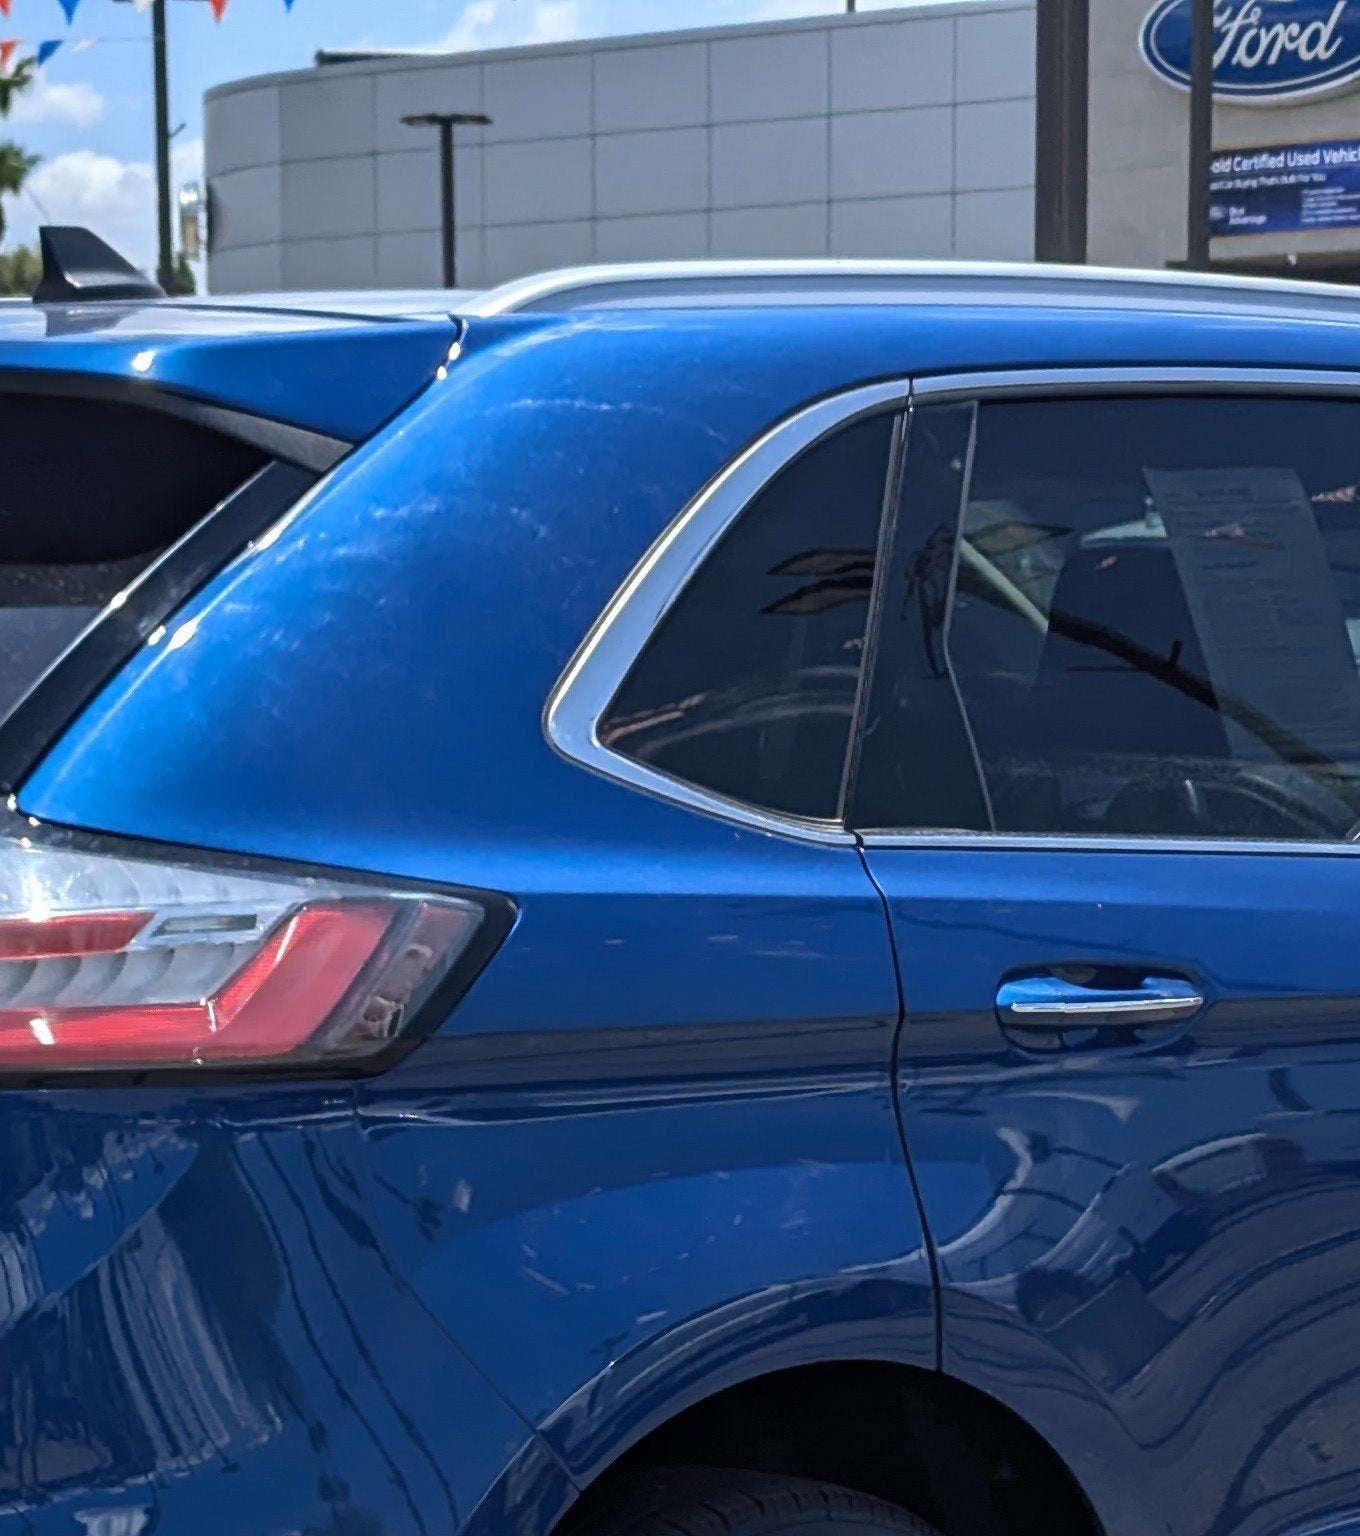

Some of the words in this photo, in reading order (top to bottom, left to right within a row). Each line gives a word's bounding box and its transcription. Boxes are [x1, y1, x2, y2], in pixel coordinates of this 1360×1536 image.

[1213, 0, 1345, 69] Ford
[1233, 152, 1285, 172] Certified
[1286, 149, 1321, 167] Used
